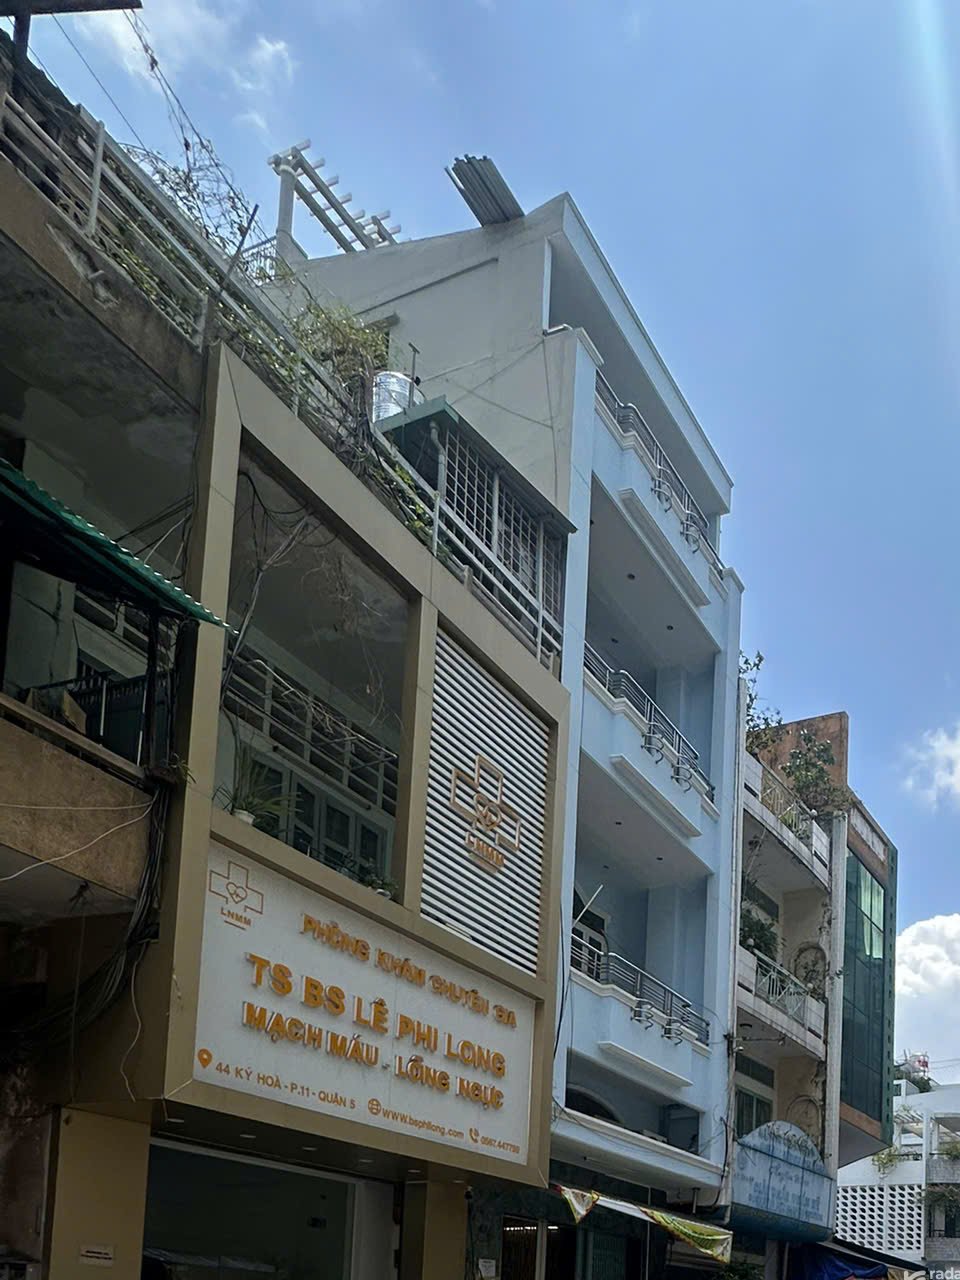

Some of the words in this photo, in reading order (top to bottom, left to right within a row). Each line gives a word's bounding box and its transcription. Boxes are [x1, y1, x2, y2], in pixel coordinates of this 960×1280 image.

[221, 906, 252, 926] LNMM
[375, 948, 426, 987] KHÁM
[245, 952, 292, 996] TS
[301, 975, 346, 1016] BS
[353, 996, 389, 1034] LÊ
[396, 1013, 439, 1053] PHI
[444, 1032, 506, 1078] LONG
[242, 1001, 323, 1050] MẠCH
[326, 1032, 379, 1067] MÁU
[395, 1055, 450, 1093] LỒNG
[456, 1076, 504, 1111] NGỰC
[215, 1062, 230, 1075] 44
[290, 1082, 310, 1097] P.11
[349, 1099, 356, 1109] 5
